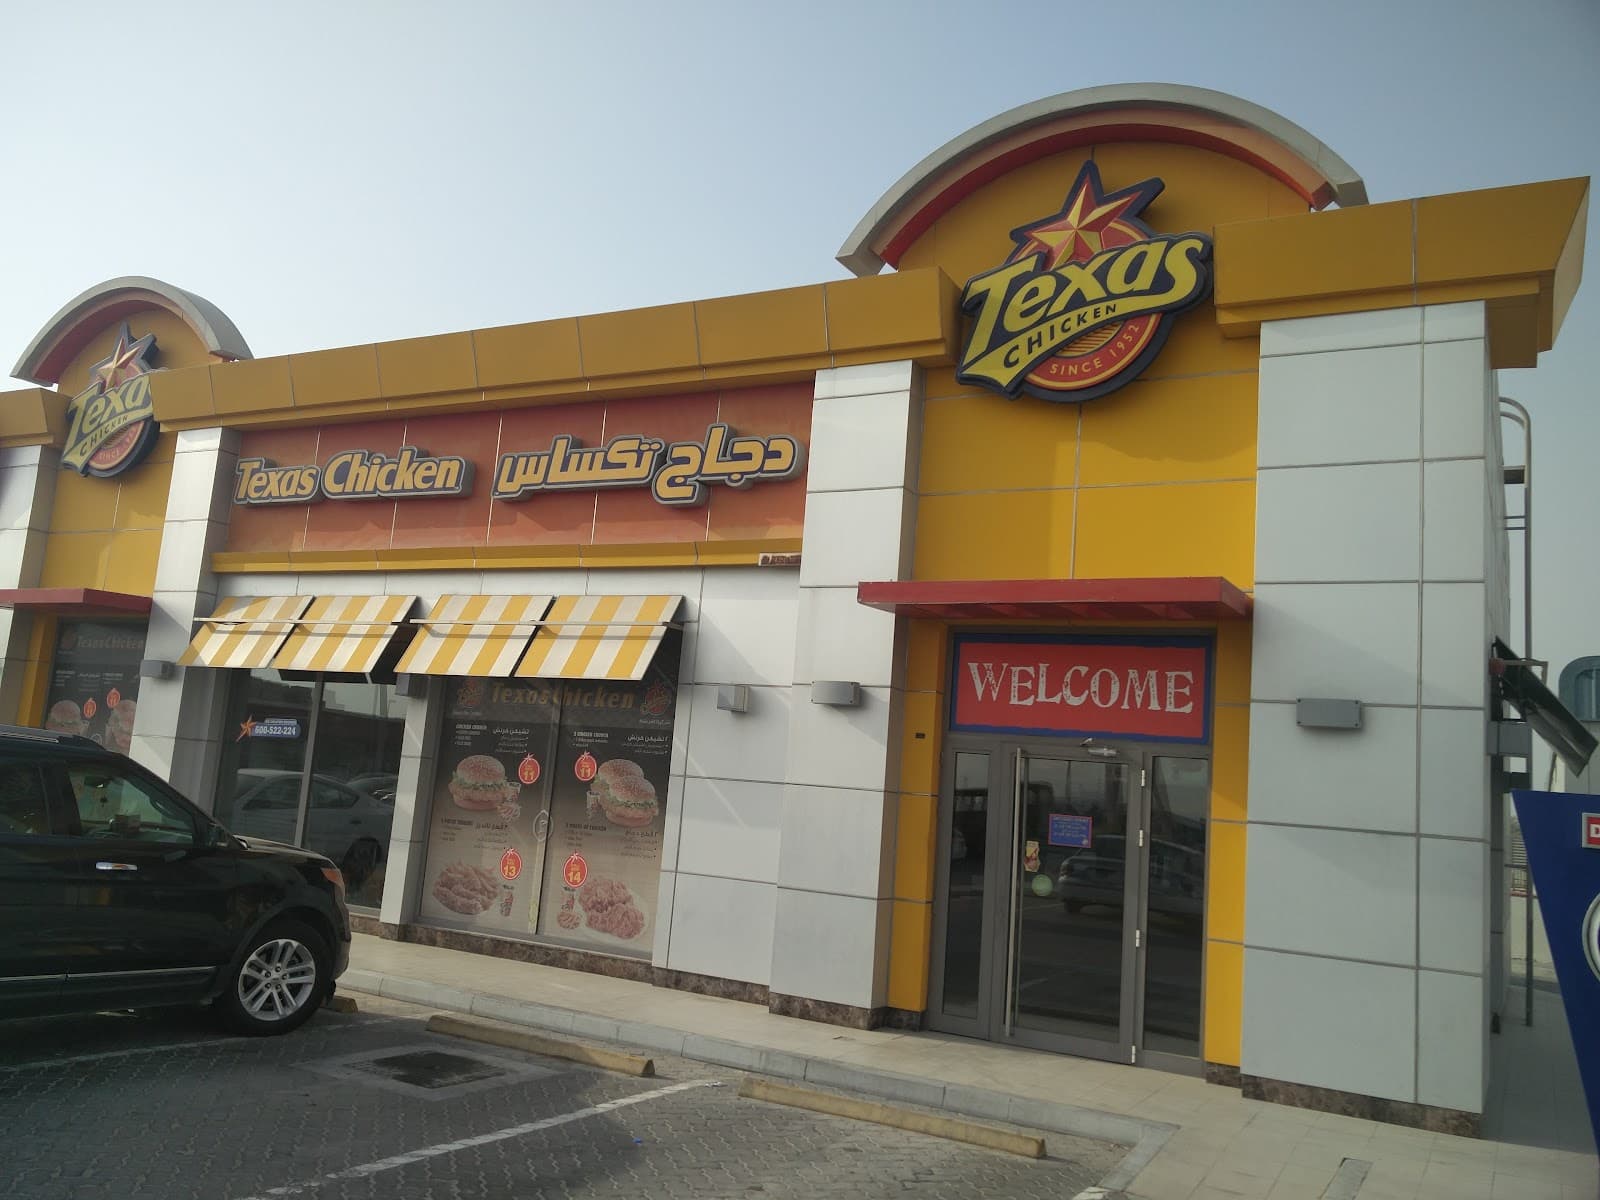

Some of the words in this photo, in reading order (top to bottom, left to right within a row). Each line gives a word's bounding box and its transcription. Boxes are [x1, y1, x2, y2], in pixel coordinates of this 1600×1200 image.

[962, 237, 1204, 367] Texas
[1003, 303, 1117, 369] CHICKEN
[1049, 358, 1103, 377] SINCE
[1109, 323, 1140, 358] 1952
[63, 375, 153, 455] Texa
[79, 415, 129, 457] CHICKEN
[236, 460, 318, 500] Texas
[323, 448, 460, 494] Chicken
[497, 437, 661, 494] تكساس
[656, 426, 794, 499] دجاج
[967, 662, 1194, 714] WELCOME
[503, 864, 517, 876] 13
[568, 871, 582, 883] 14
